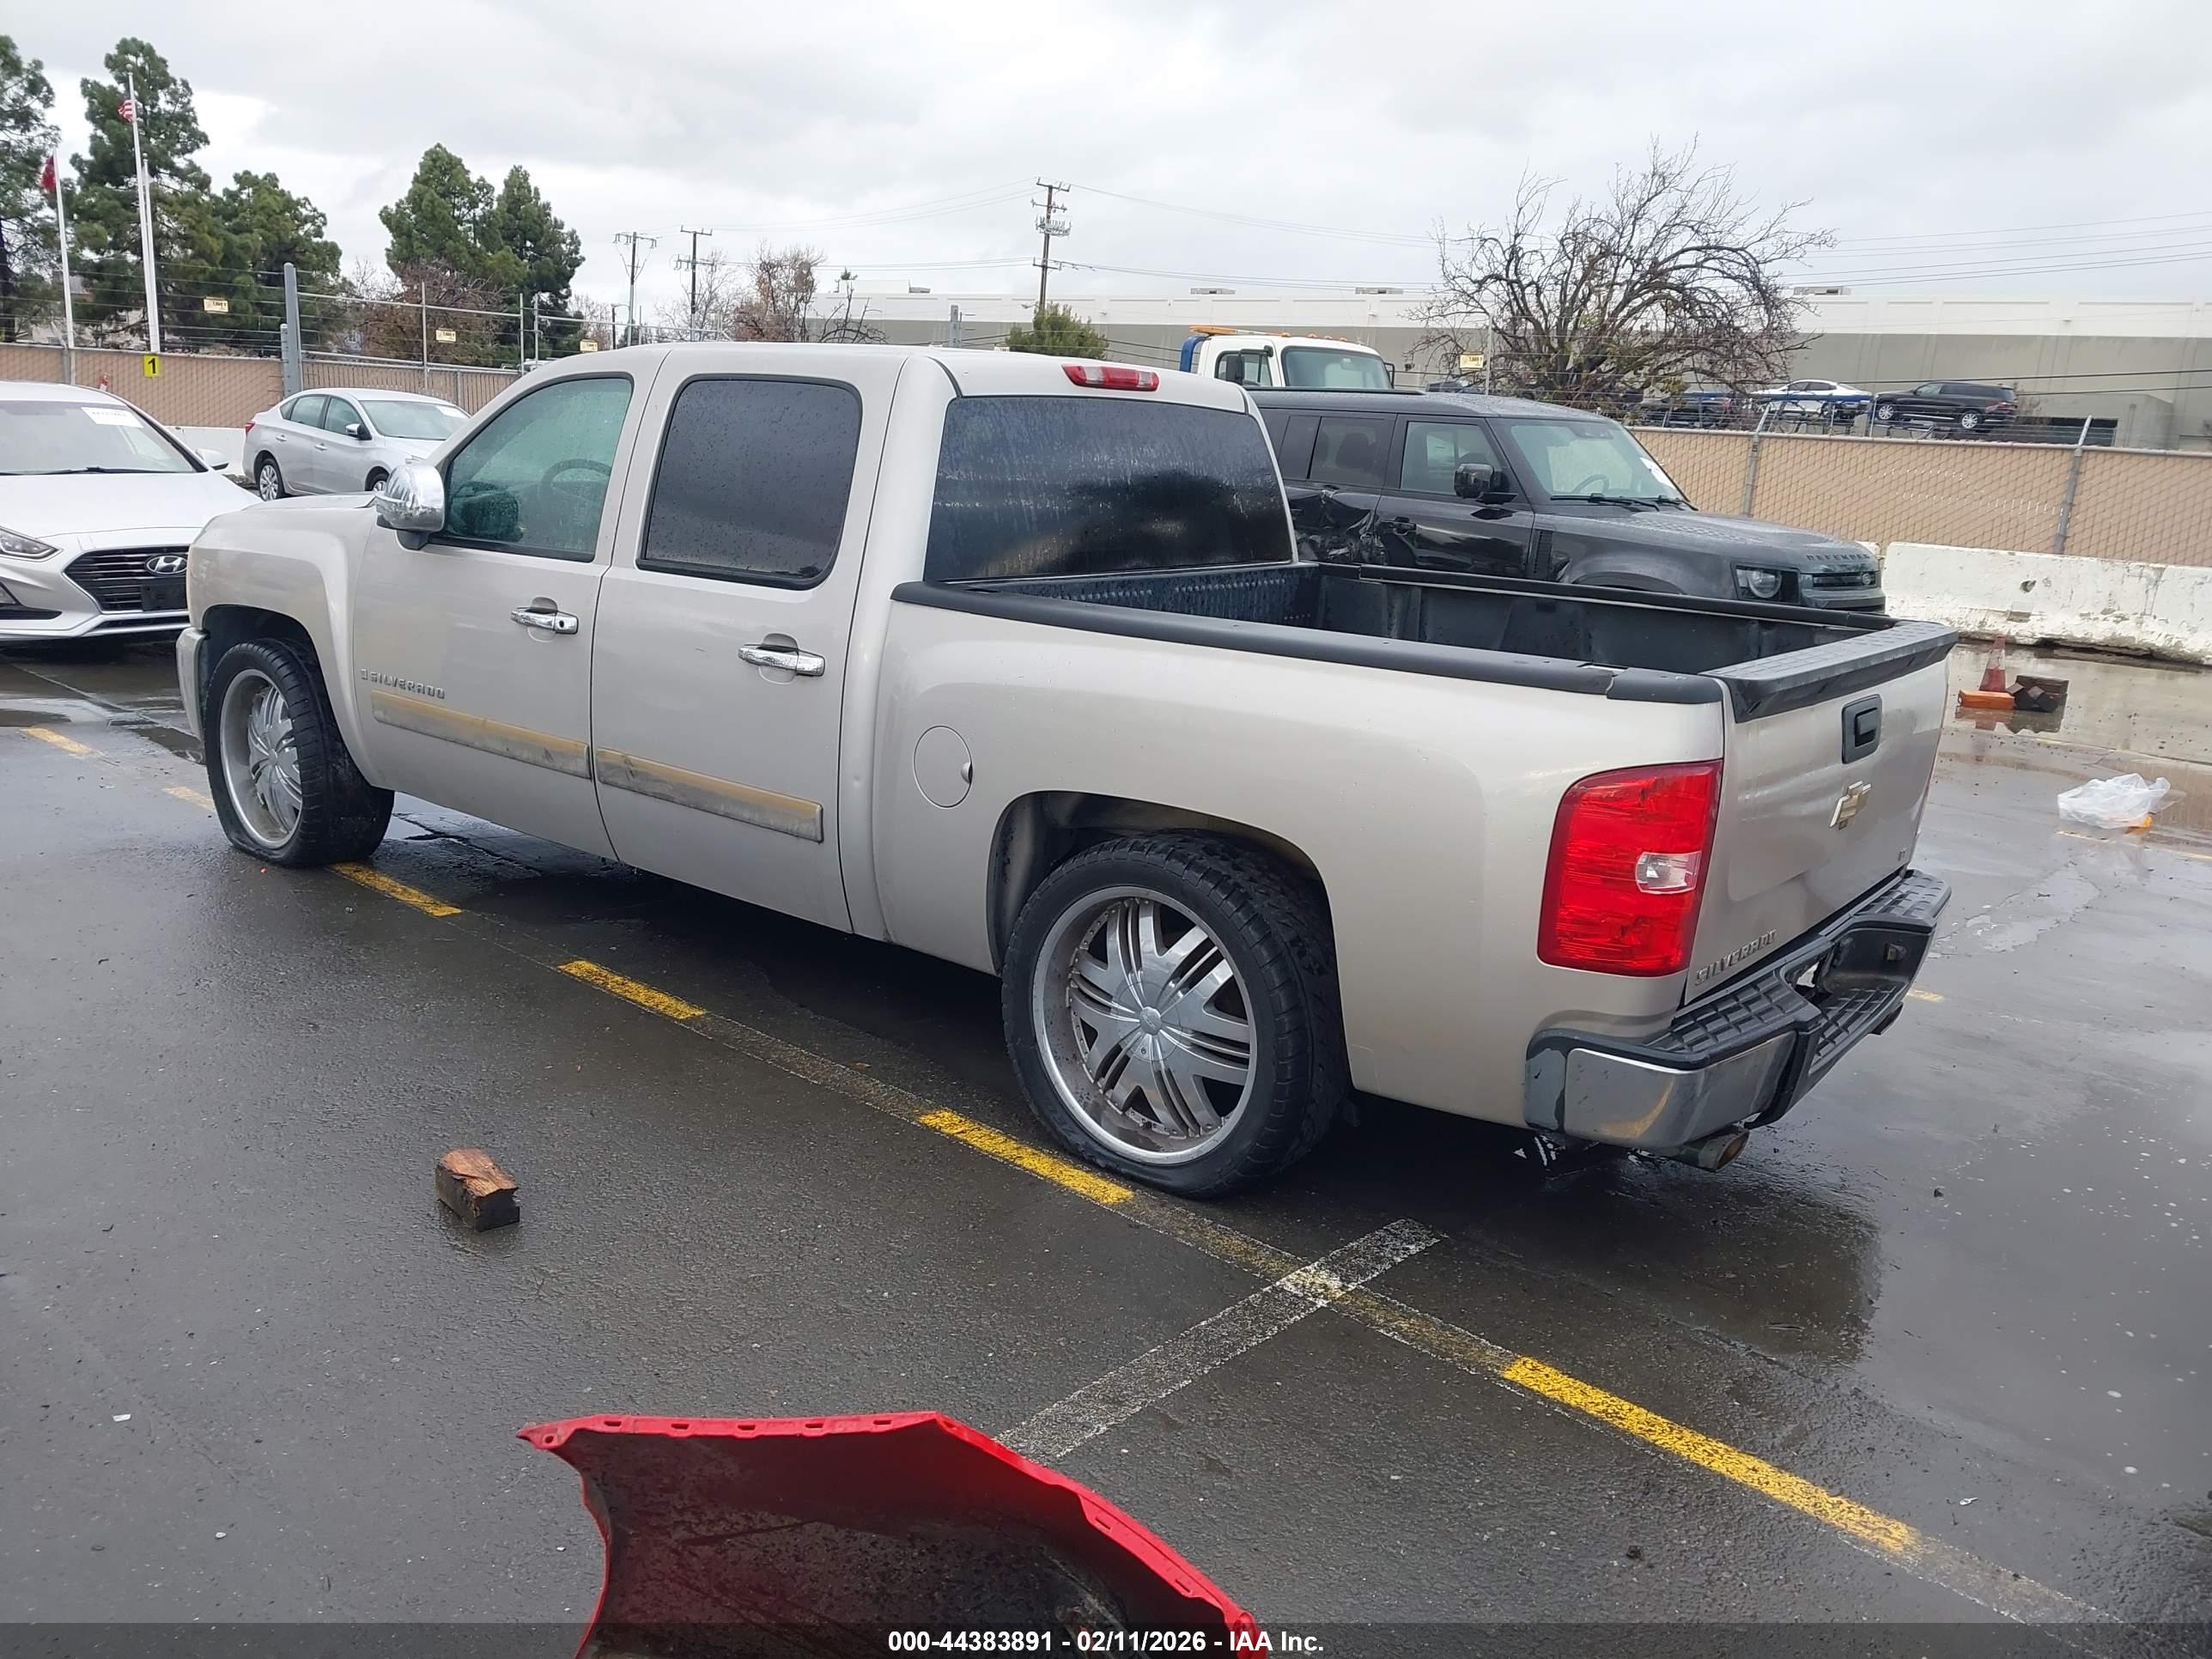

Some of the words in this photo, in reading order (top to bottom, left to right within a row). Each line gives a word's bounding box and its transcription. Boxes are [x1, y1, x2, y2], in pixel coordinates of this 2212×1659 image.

[148, 357, 156, 374] 1
[370, 671, 445, 700] SILVERADO
[1695, 928, 1777, 987] SILVERADO
